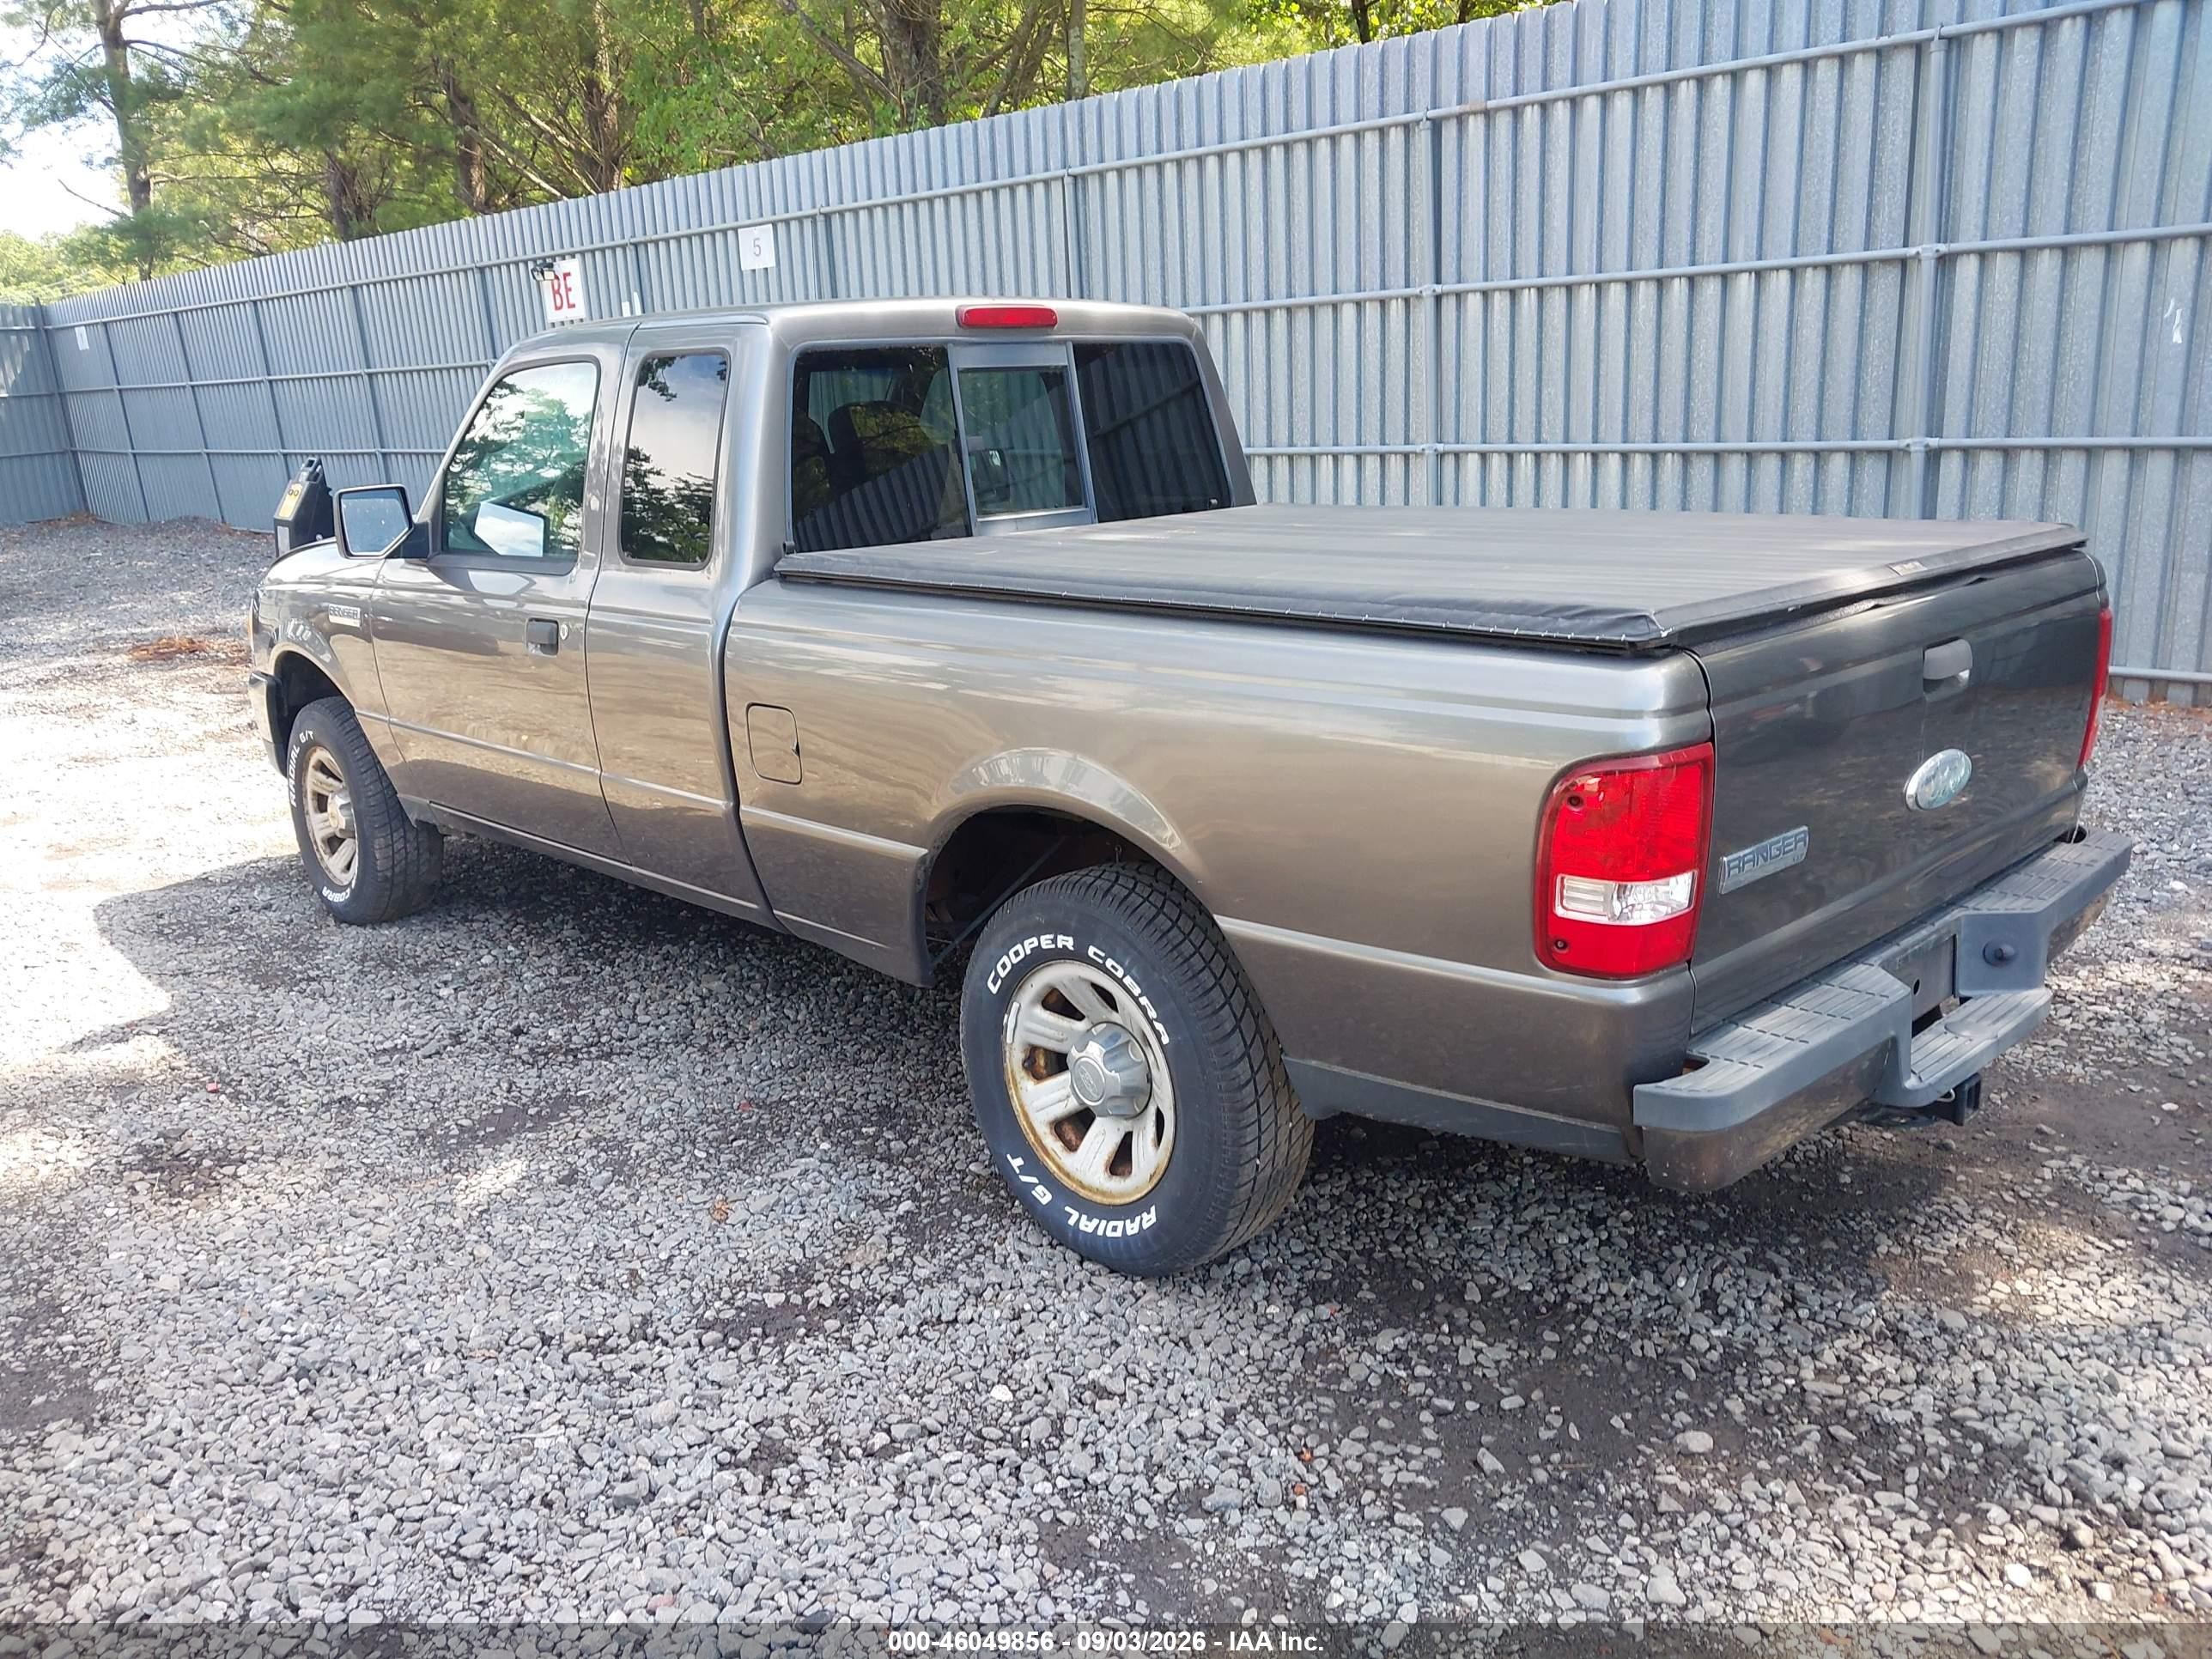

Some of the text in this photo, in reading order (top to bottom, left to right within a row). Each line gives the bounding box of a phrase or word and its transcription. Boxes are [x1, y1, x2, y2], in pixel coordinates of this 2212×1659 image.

[753, 237, 762, 257] 5
[550, 271, 576, 311] BE
[289, 730, 314, 808] RADIAL G/T
[1727, 830, 1808, 878] RANGER
[322, 886, 350, 902] COBRA
[988, 933, 1170, 1045] COOPER COBRA
[1006, 1153, 1157, 1237] RADIAL G/T
